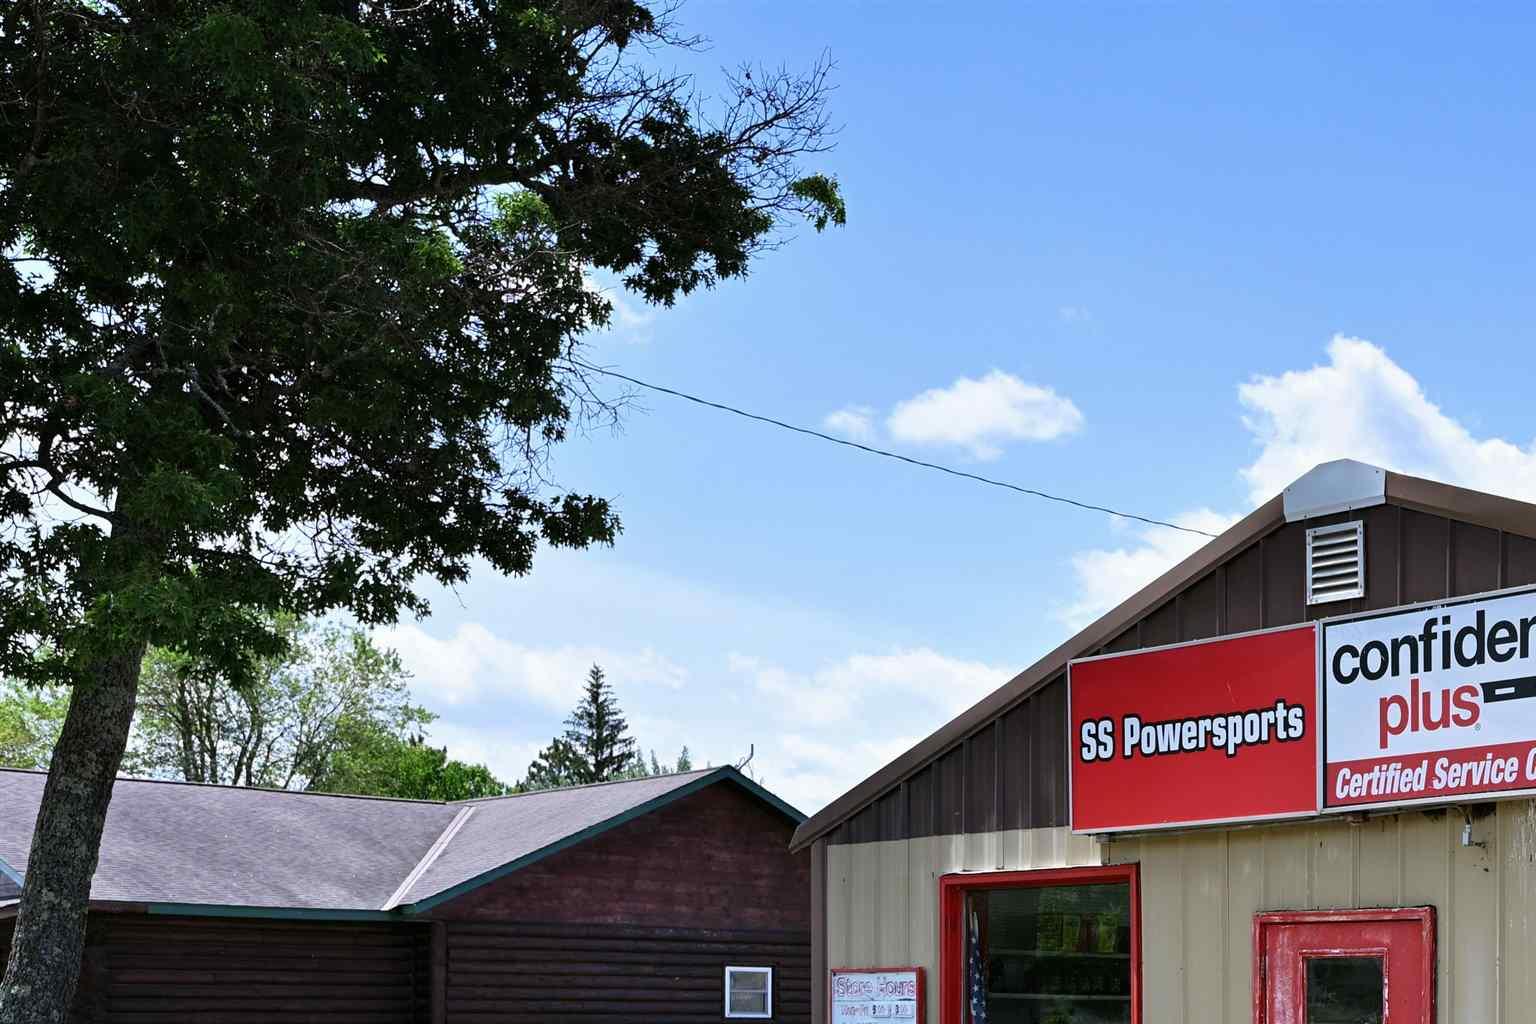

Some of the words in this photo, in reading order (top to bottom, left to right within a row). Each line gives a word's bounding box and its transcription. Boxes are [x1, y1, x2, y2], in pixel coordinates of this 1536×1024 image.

[1081, 719, 1114, 761] SS
[1123, 701, 1304, 755] Powersports
[1379, 678, 1481, 749] plus
[1336, 759, 1428, 799] Certified
[1432, 752, 1519, 790] Service
